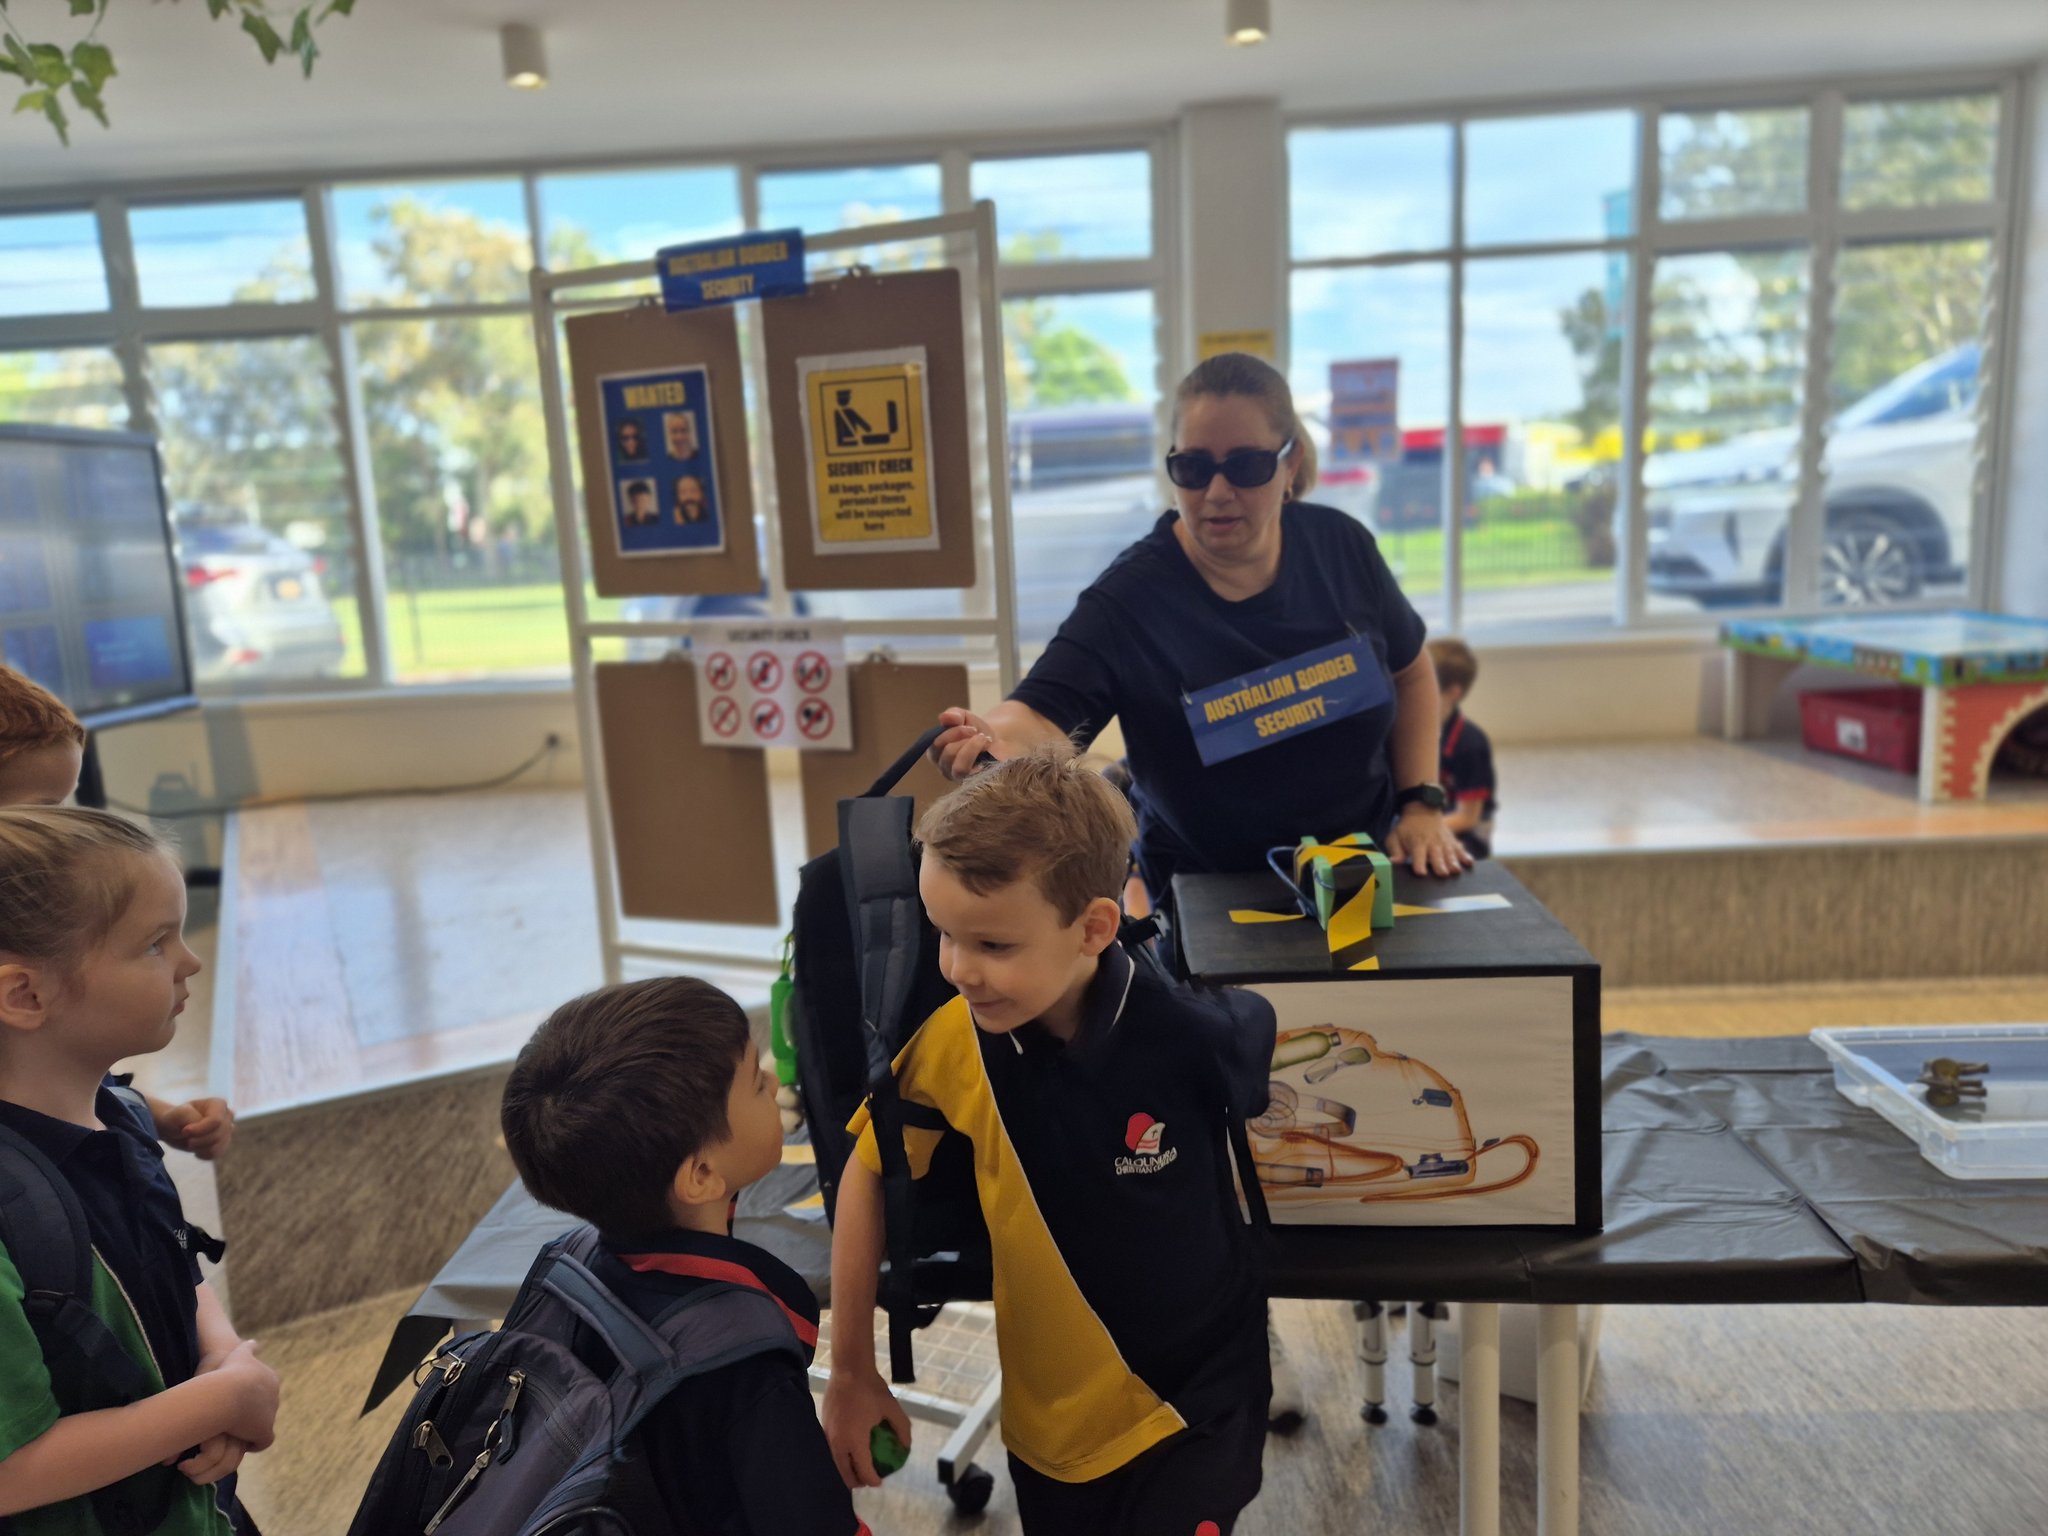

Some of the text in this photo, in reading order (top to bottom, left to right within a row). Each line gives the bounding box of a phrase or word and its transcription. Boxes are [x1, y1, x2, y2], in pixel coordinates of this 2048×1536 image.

[624, 382, 685, 408] WANTED
[828, 458, 913, 477] SECURITY CHECK
[828, 483, 841, 494] All
[839, 495, 905, 507] personal items
[836, 507, 911, 520] will be inspected
[864, 521, 885, 531] here
[1204, 653, 1358, 723] AUSTRALIAN BORDER
[1254, 695, 1326, 737] SECURITY
